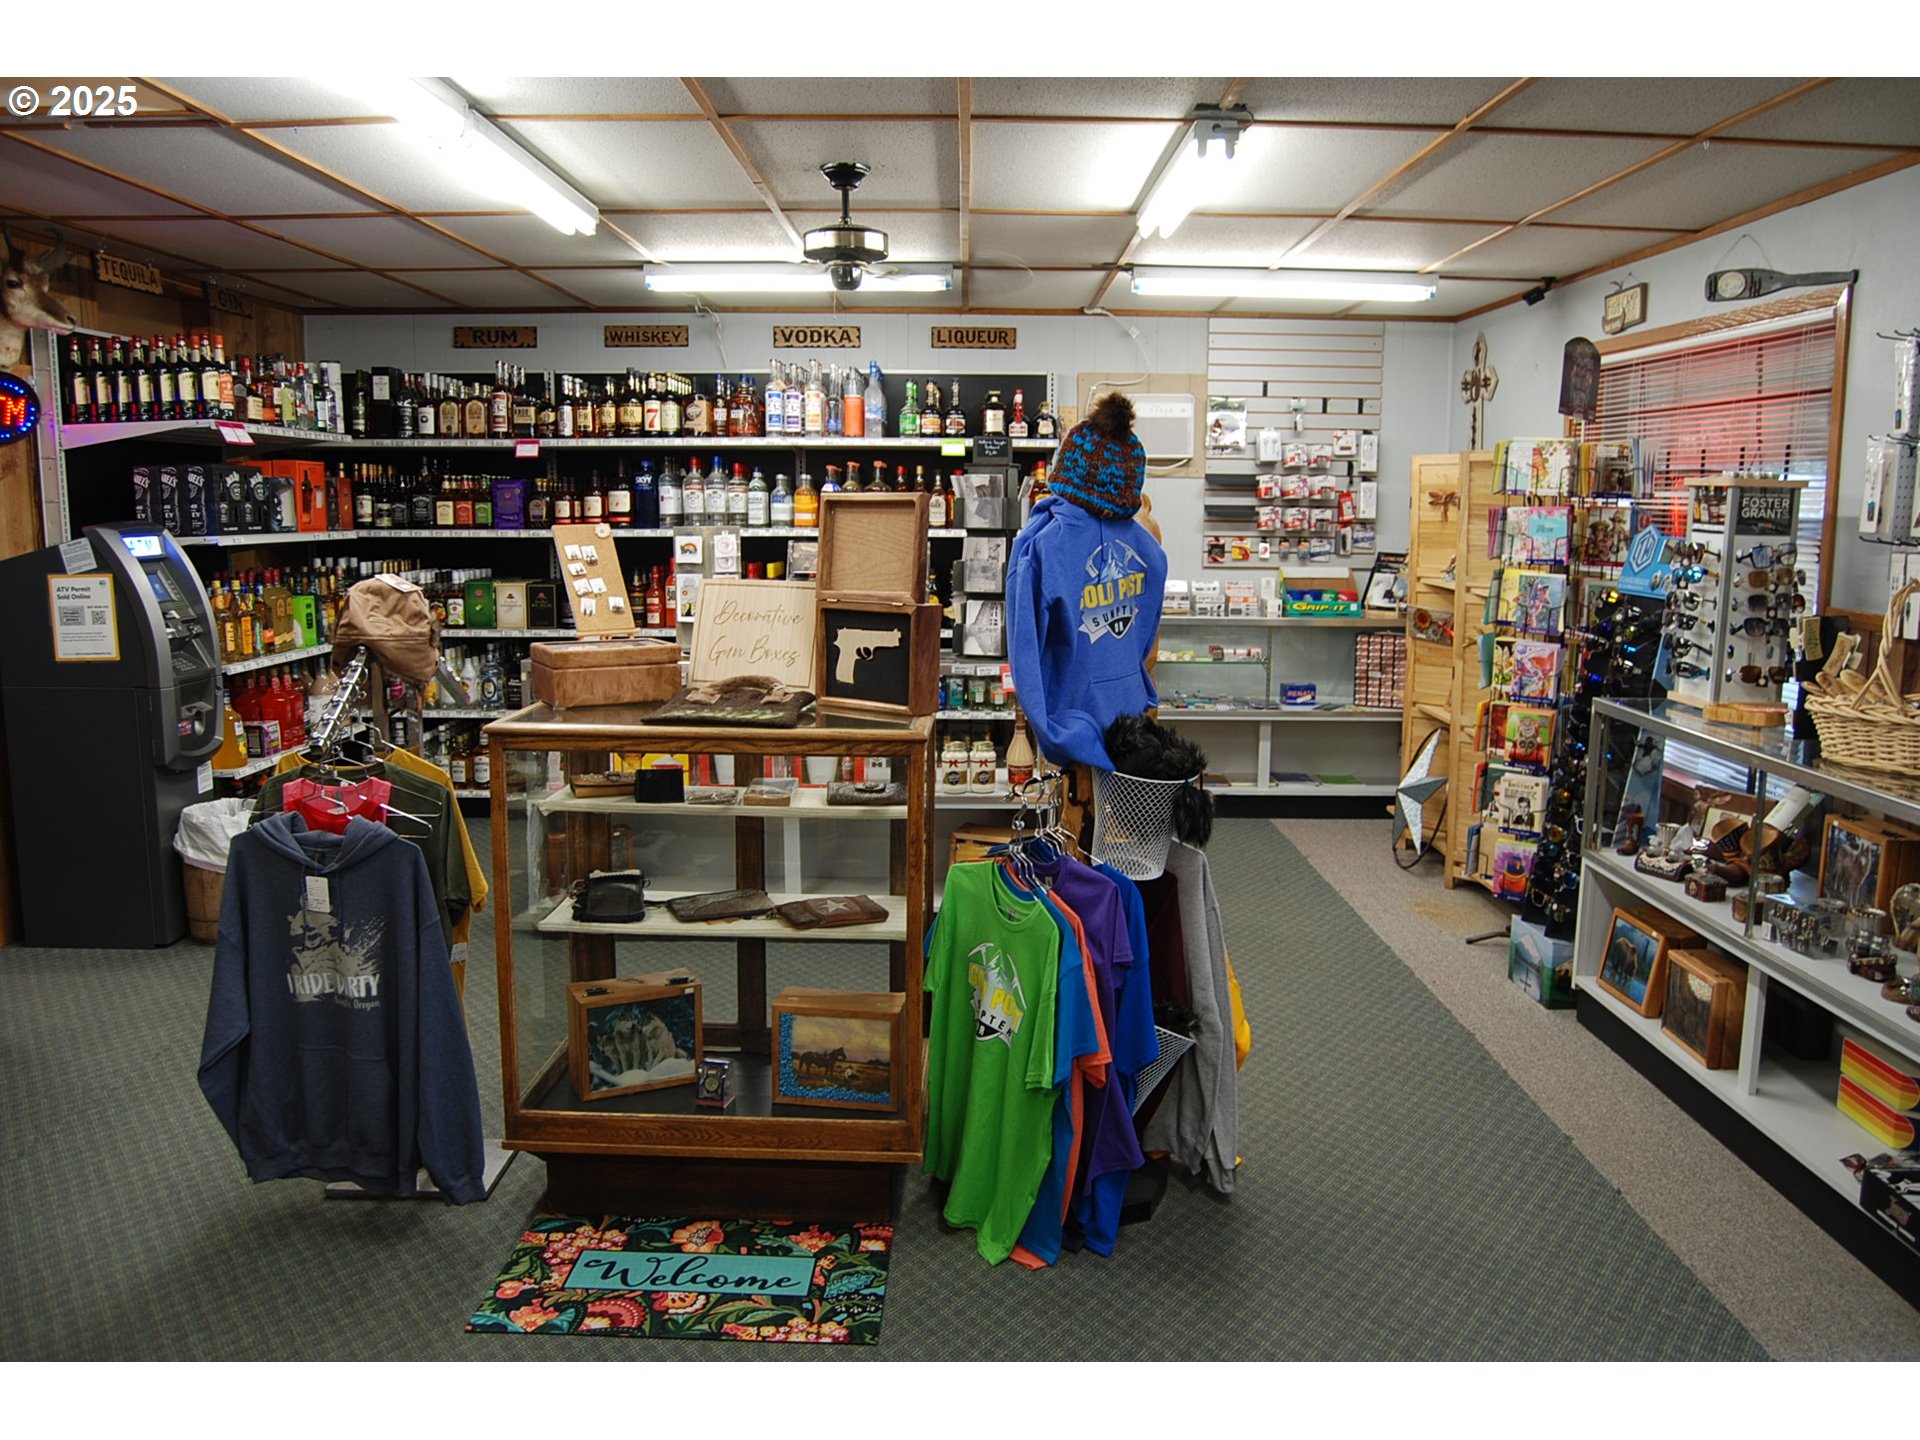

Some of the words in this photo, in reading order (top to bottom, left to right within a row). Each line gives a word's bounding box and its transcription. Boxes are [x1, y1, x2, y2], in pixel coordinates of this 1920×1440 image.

[100, 256, 158, 288] TEQUILA
[472, 329, 519, 344] RUM
[609, 329, 683, 343] WHISKEY
[780, 329, 853, 344] VODKA
[936, 329, 1009, 345] LIQUEUR
[646, 408, 659, 429] 7
[634, 474, 653, 485] SKYY
[1742, 497, 1790, 509] FOSTER
[56, 593, 70, 601] Sold
[1080, 582, 1115, 609] OLD
[1118, 572, 1145, 601] PST
[714, 600, 804, 632] Decorative
[709, 635, 735, 666] Gun
[747, 634, 800, 668] Boxes
[286, 973, 294, 994] I
[294, 972, 335, 995] RIDE
[353, 998, 381, 1011] Oregon
[583, 1255, 802, 1290] Welcome
